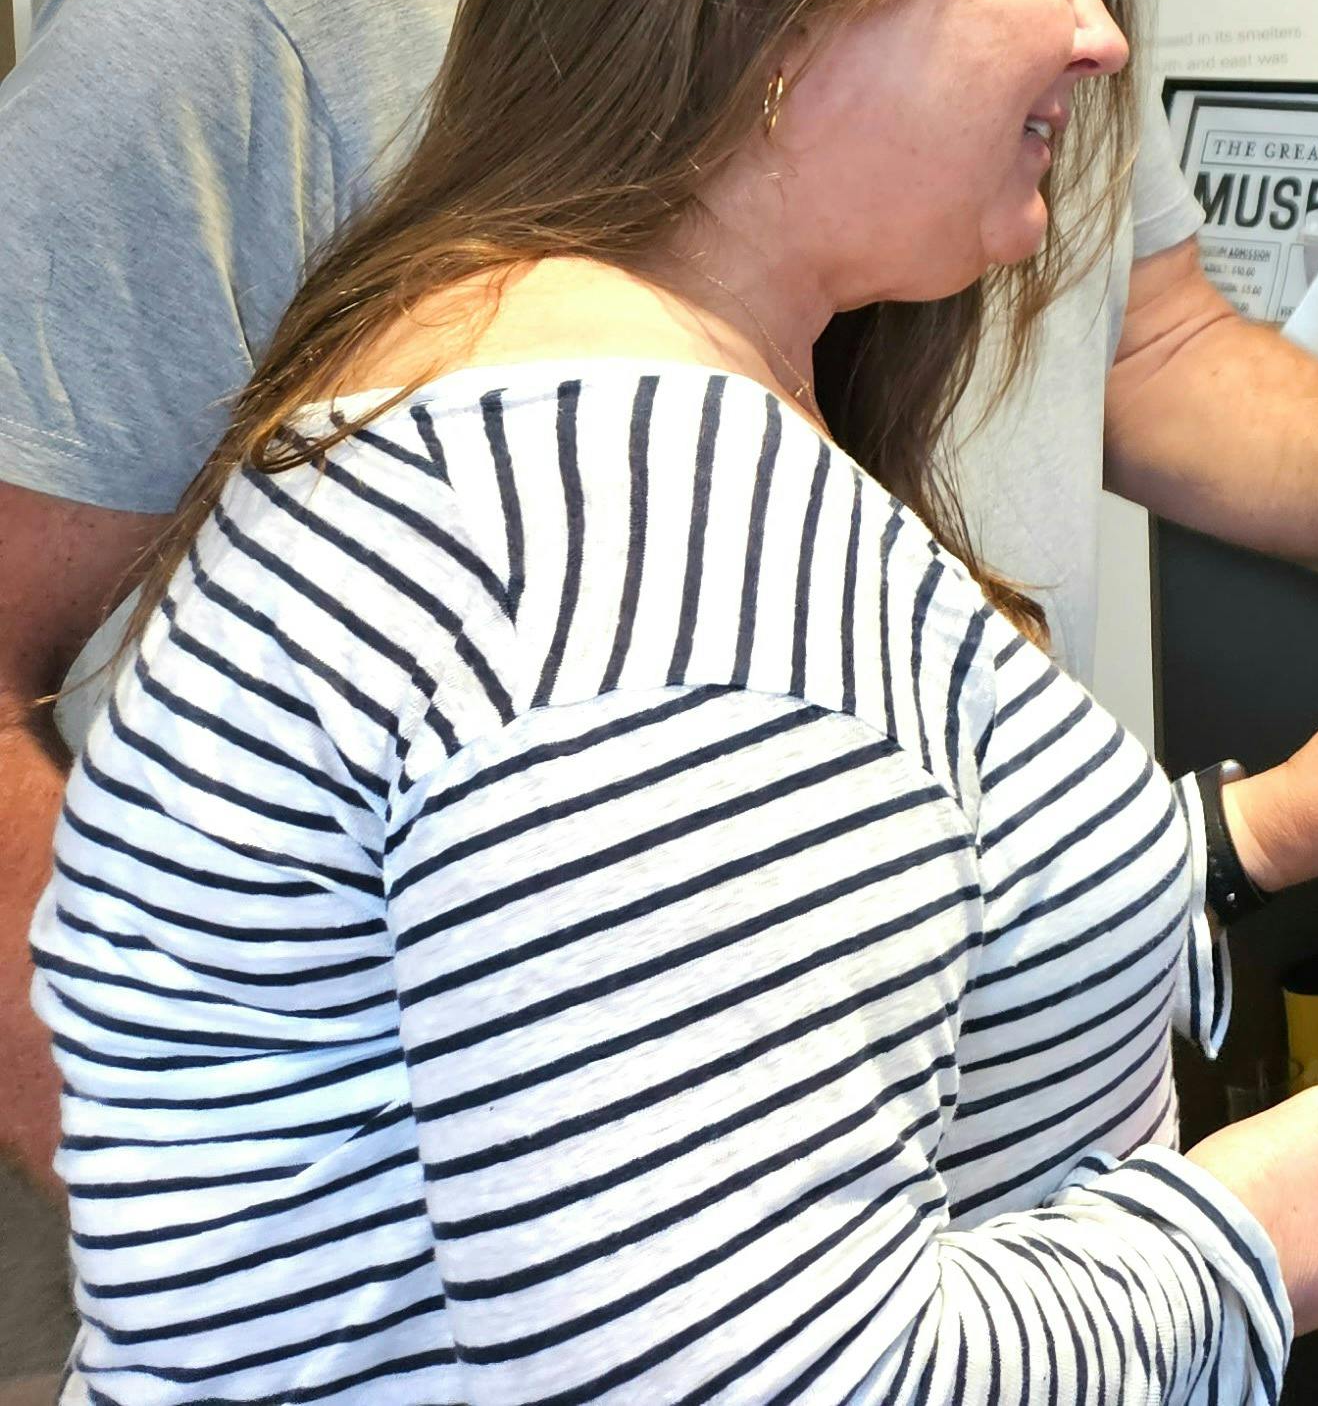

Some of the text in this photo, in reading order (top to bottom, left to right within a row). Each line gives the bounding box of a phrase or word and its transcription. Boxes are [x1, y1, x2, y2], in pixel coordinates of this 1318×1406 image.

[1238, 27, 1301, 42] smelters
[1187, 56, 1215, 71] and
[1213, 138, 1257, 158] THE
